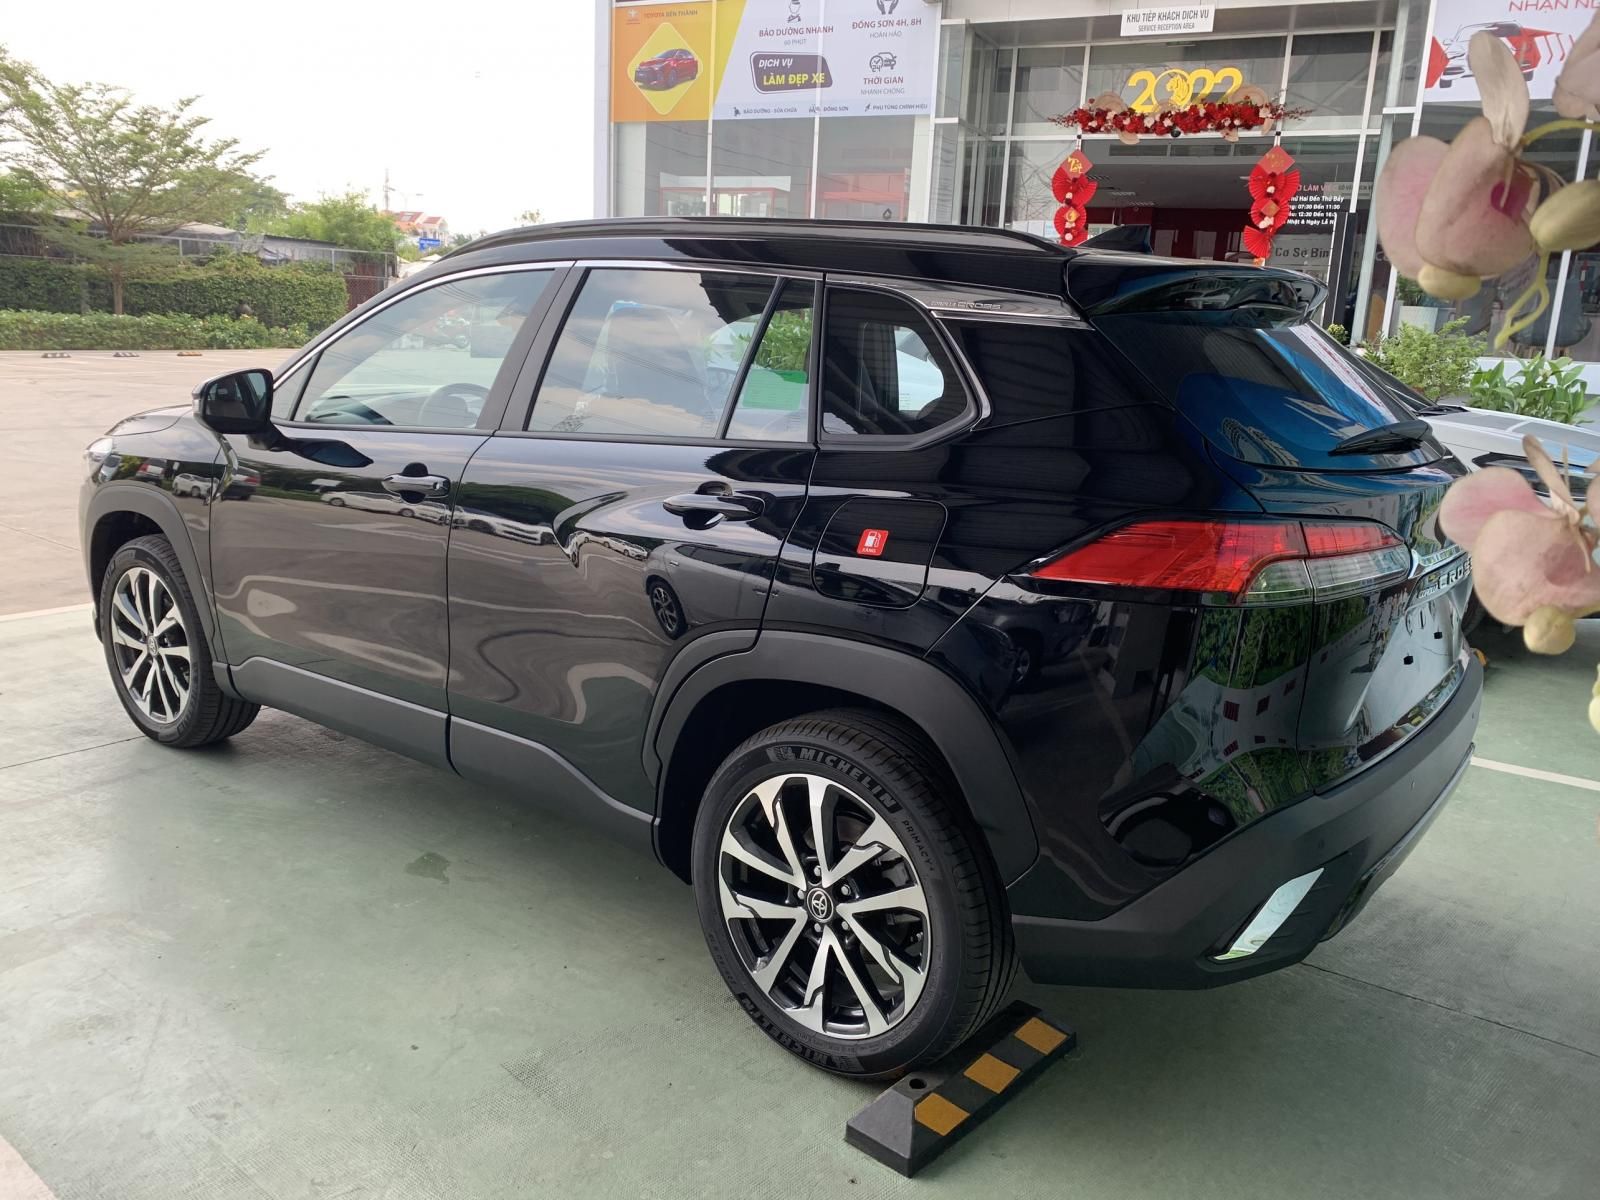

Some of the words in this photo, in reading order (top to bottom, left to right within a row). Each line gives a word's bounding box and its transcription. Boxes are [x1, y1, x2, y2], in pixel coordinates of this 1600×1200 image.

[1126, 13, 1140, 23] KHU
[1142, 11, 1157, 22] TIẾP
[1158, 10, 1180, 21] KHÁCH
[1182, 9, 1198, 21] DỊCH
[877, 19, 894, 28] SƠN
[910, 17, 922, 26] 8H
[1138, 24, 1156, 32] SERVICE
[1157, 23, 1182, 31] RECEPTION
[776, 26, 804, 36] DƯỠNG
[805, 26, 834, 34] NHANH
[758, 58, 780, 70] DỊCH
[781, 57, 793, 69] VỤ
[763, 72, 785, 86] LÀM
[788, 73, 809, 87] ĐẸP
[811, 72, 825, 84] XE
[863, 76, 882, 86] THỜI
[884, 76, 904, 85] GIAN
[1303, 183, 1319, 192] LÀM
[1309, 194, 1320, 202] Đến
[1322, 194, 1332, 202] Thứ
[1333, 194, 1345, 203] Bảy
[1287, 218, 1300, 226] Nhật
[1306, 218, 1320, 226] Ngày
[957, 301, 1001, 310] CROSS
[800, 747, 898, 809] MICHELIN
[902, 819, 934, 865] PRIMACY
